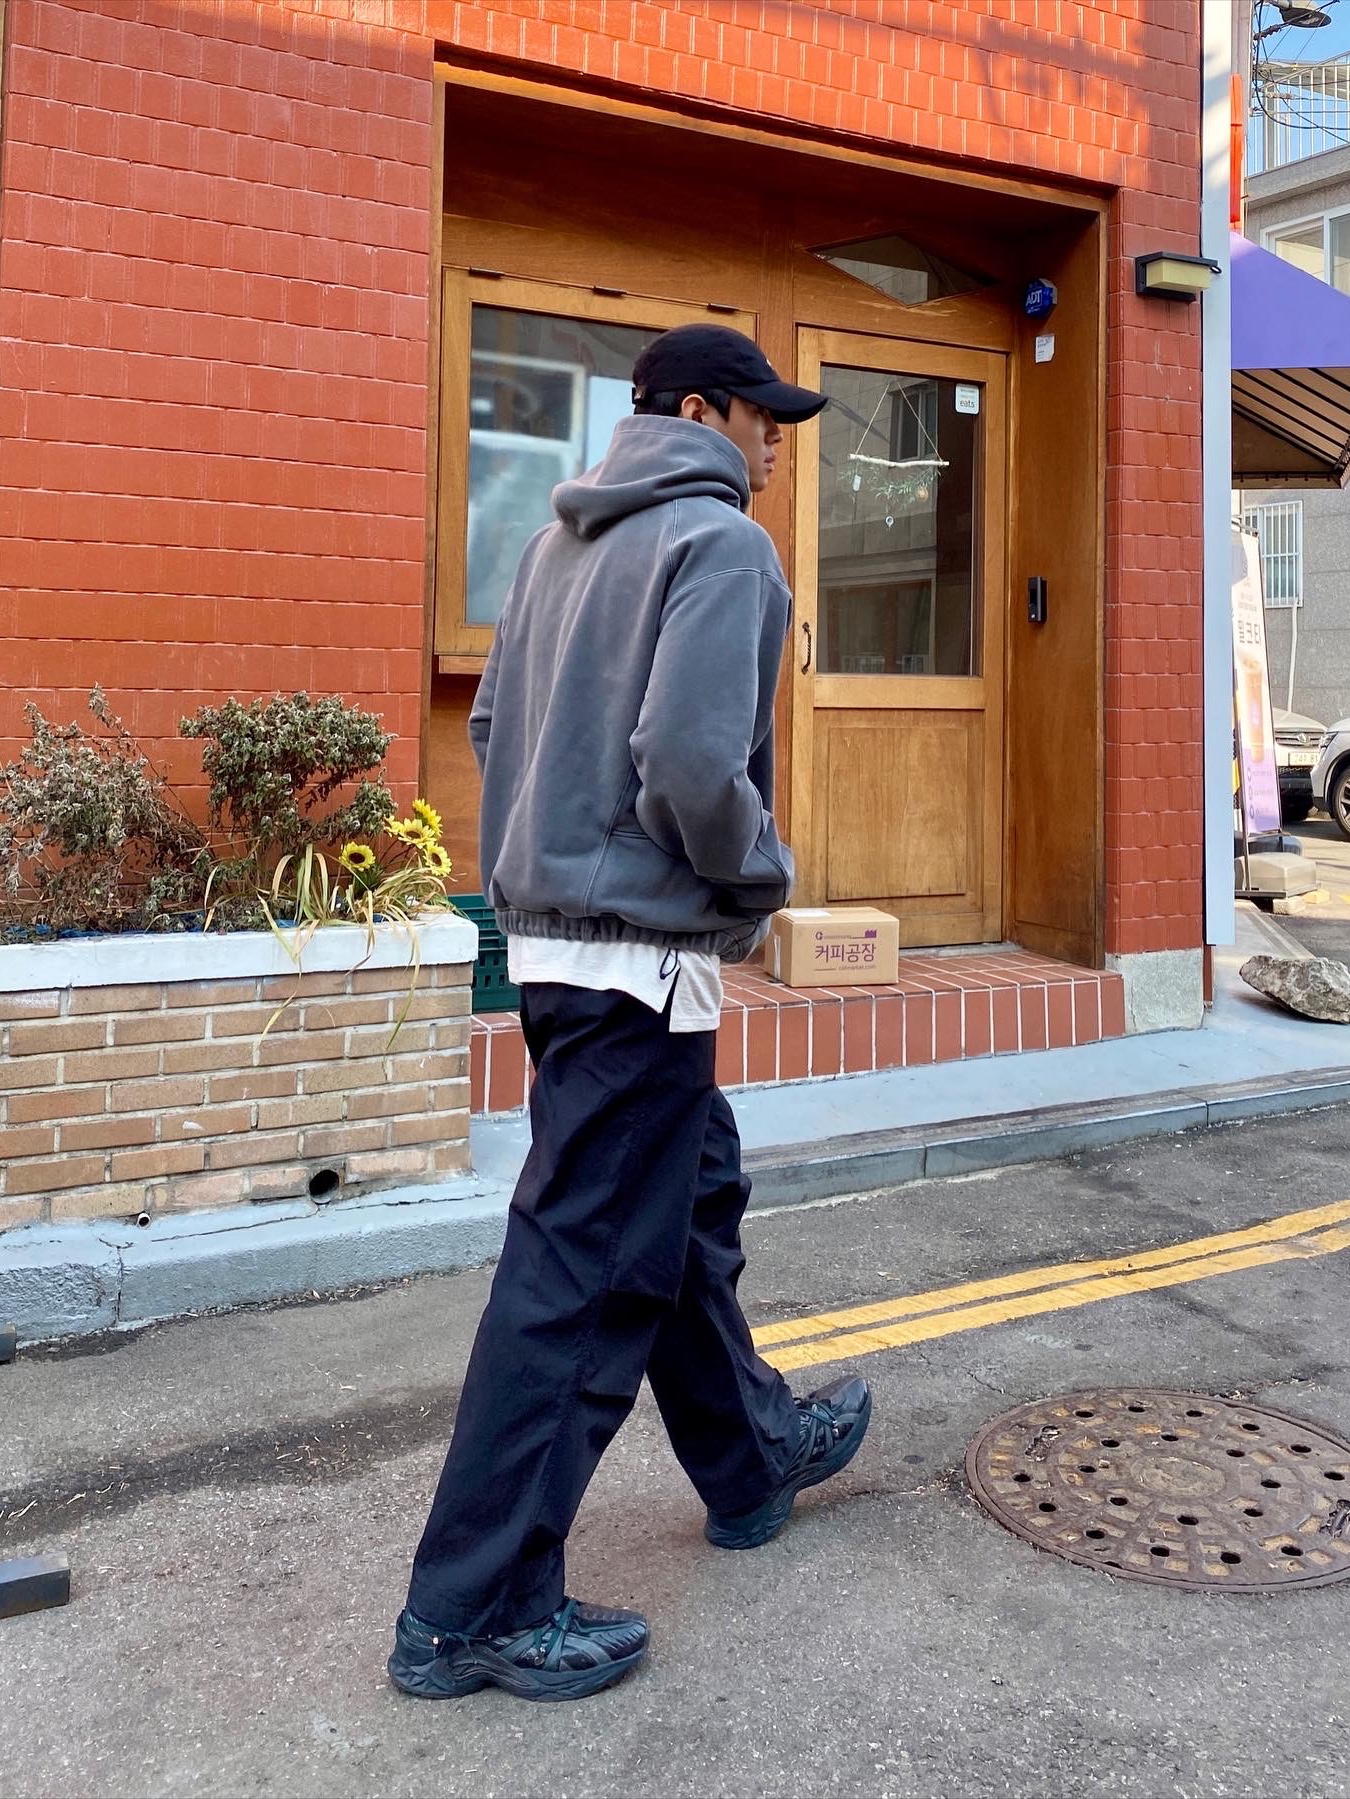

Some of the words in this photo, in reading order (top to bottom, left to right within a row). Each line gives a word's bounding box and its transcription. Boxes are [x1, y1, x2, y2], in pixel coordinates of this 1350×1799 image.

[1026, 289, 1043, 307] ADT
[959, 400, 975, 409] eats
[815, 943, 876, 963] 커피공장
